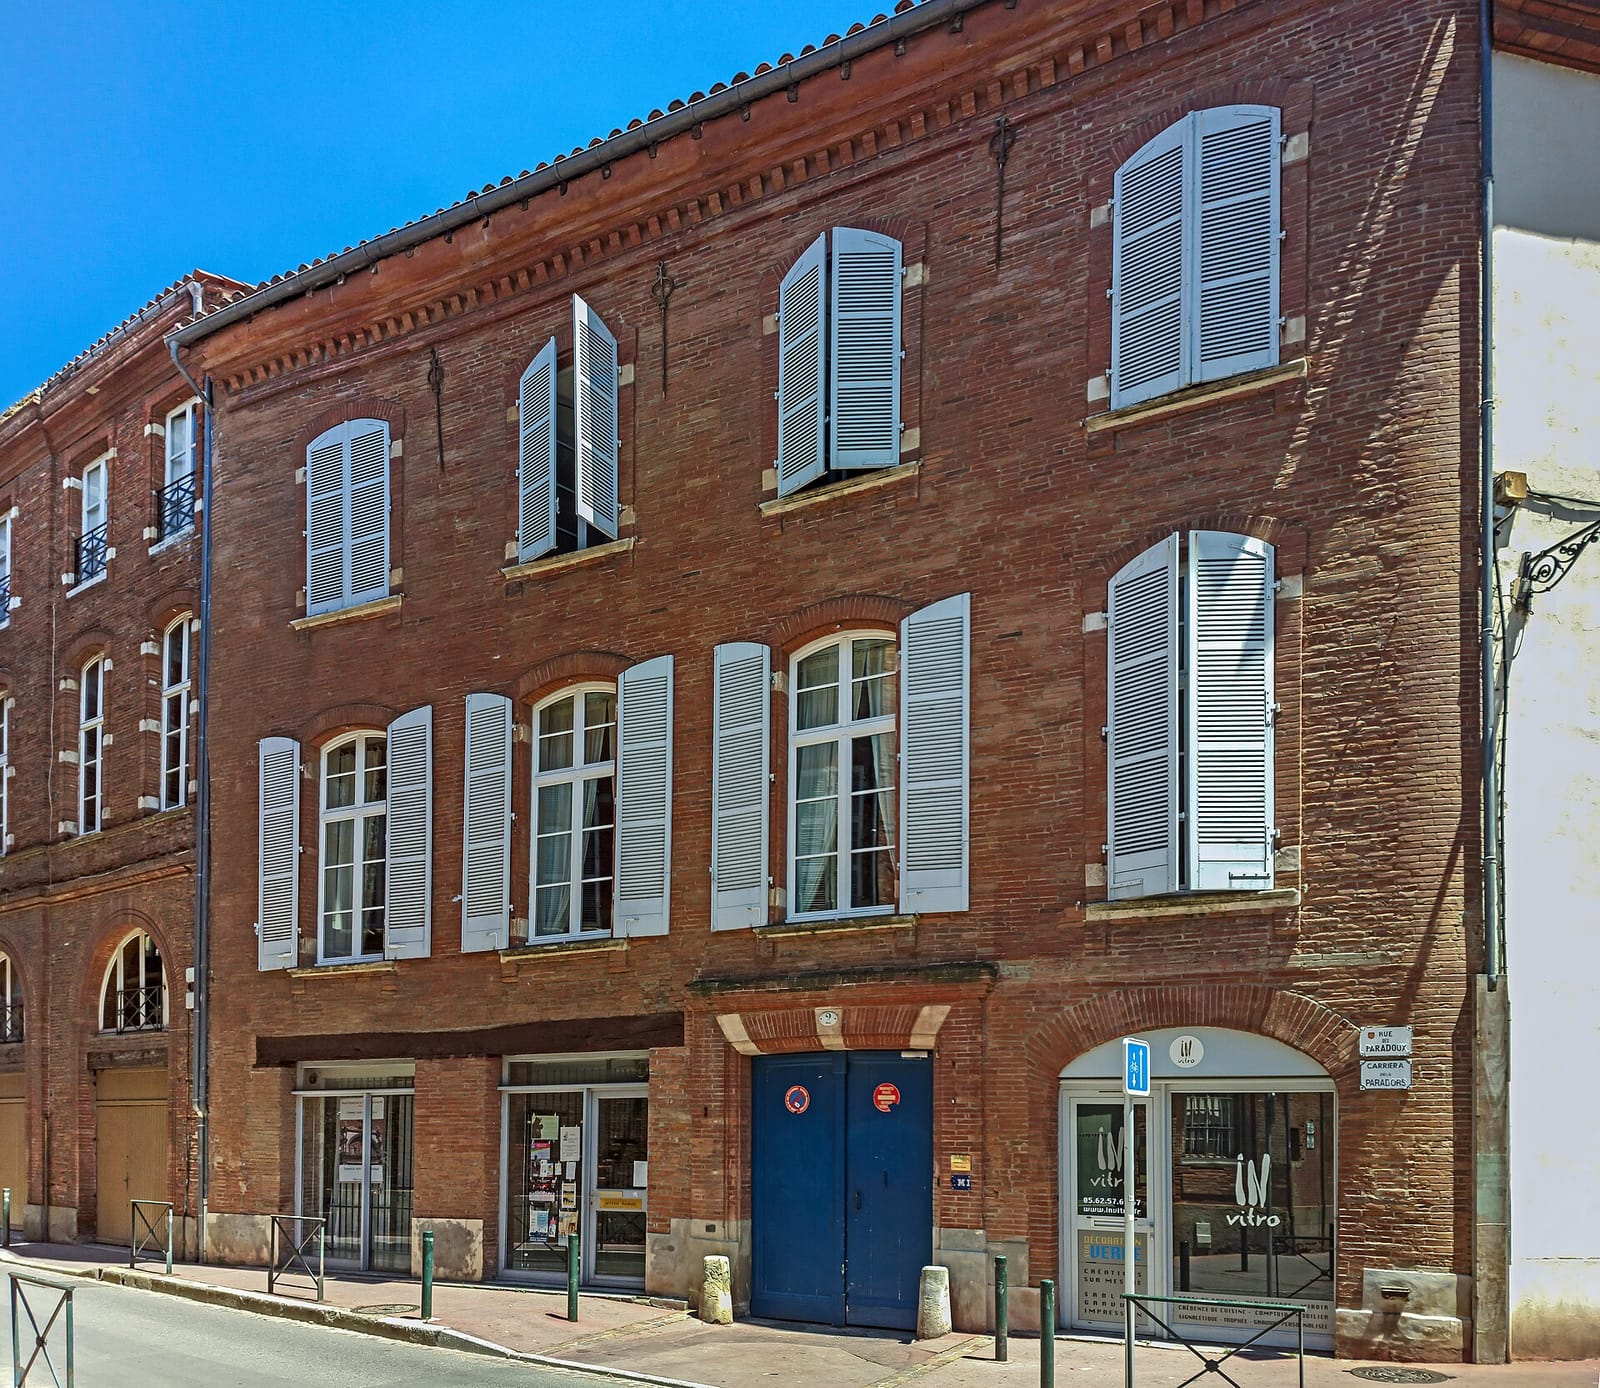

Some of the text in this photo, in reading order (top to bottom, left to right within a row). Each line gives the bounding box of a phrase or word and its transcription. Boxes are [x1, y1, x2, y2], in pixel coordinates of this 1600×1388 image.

[1365, 1044, 1407, 1052] PARADOUX
[1365, 1078, 1407, 1087] PARADORS
[1090, 1171, 1124, 1187] vitr
[1225, 1207, 1281, 1227] vitro
[1105, 1278, 1141, 1286] MESE
[1084, 1308, 1142, 1318] IMPRESSN
